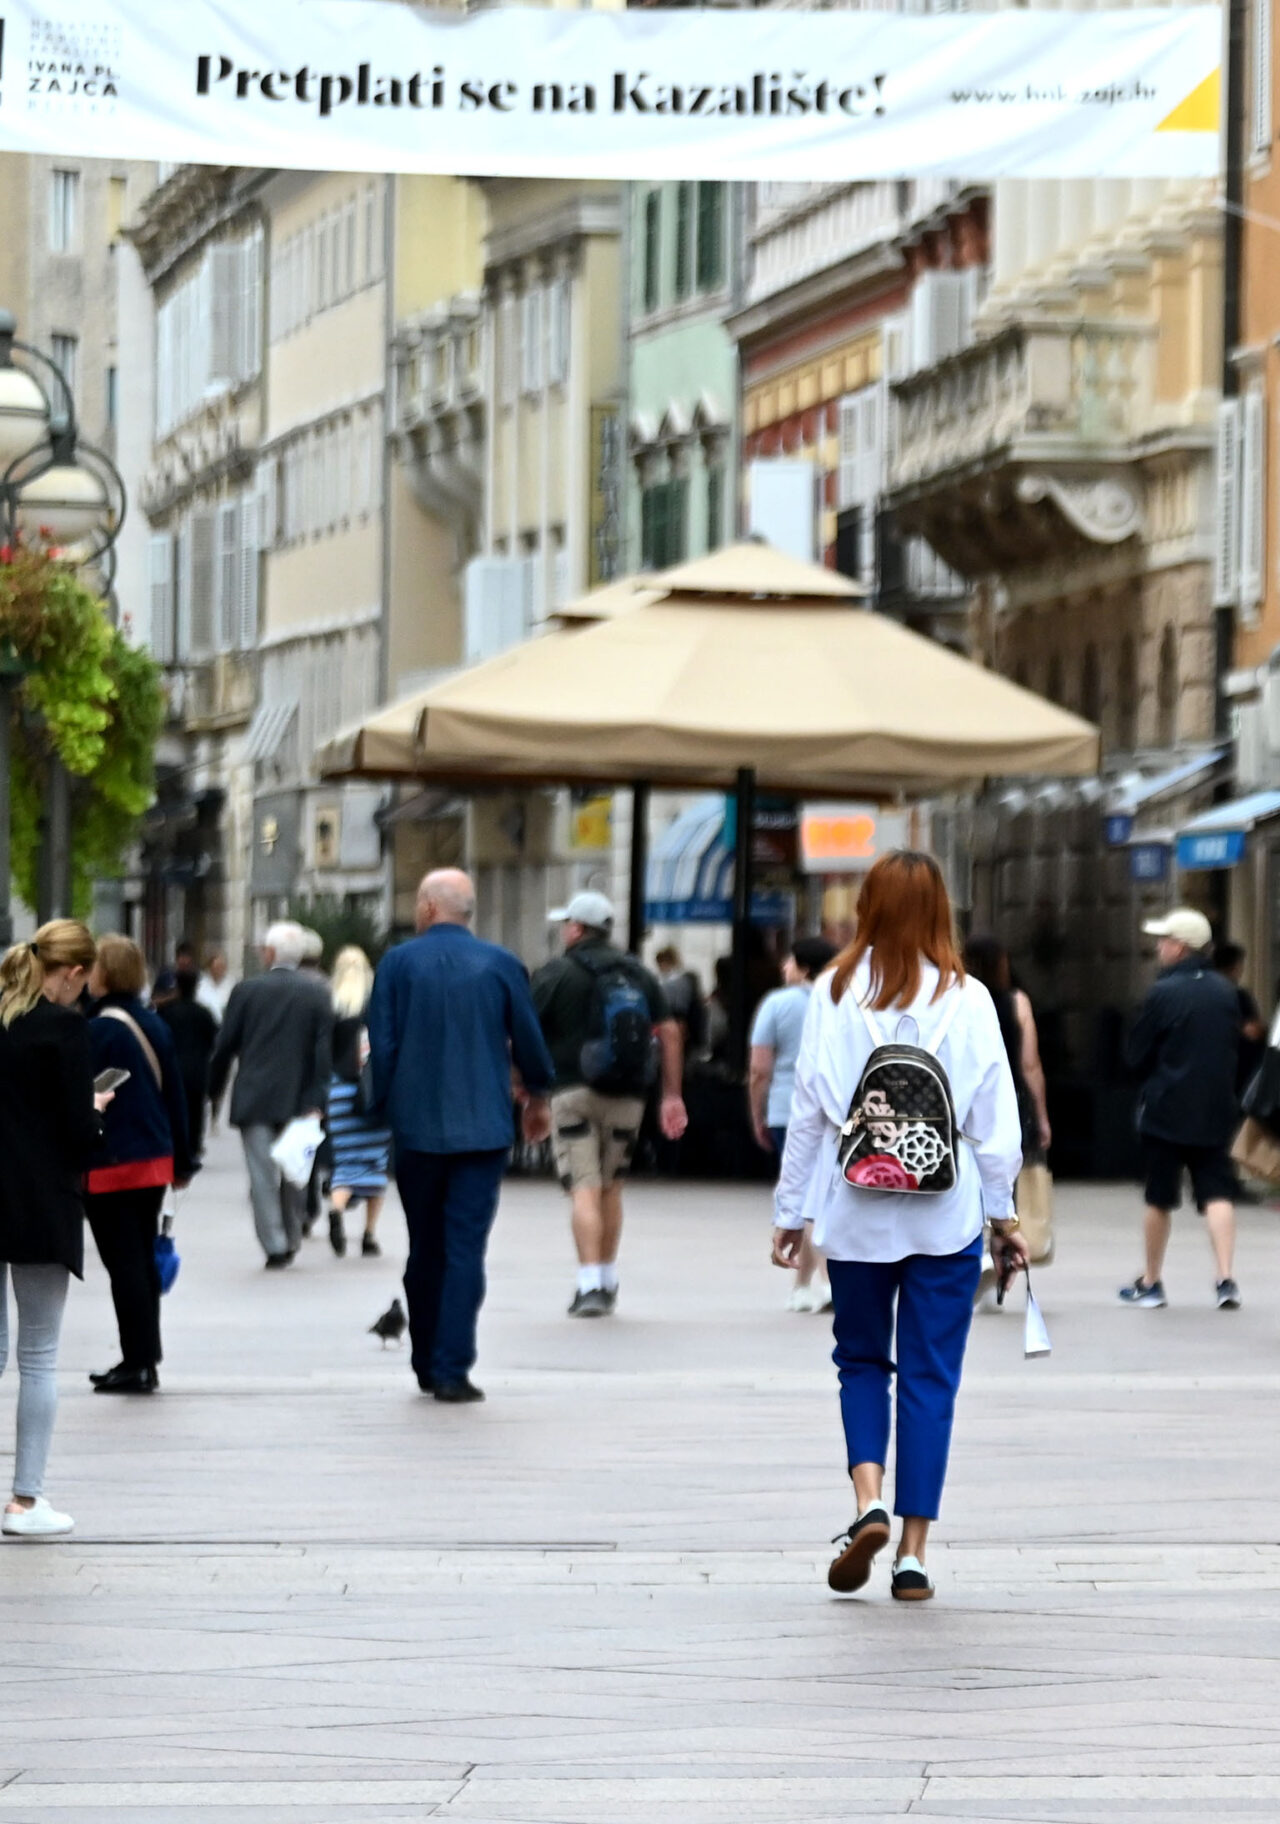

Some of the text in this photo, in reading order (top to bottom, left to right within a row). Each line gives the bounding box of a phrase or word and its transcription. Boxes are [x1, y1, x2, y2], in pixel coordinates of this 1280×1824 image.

[28, 60, 86, 76] IVANA
[28, 78, 119, 97] ZAJCA
[197, 53, 887, 118] Pretplati se na Kazalište!
